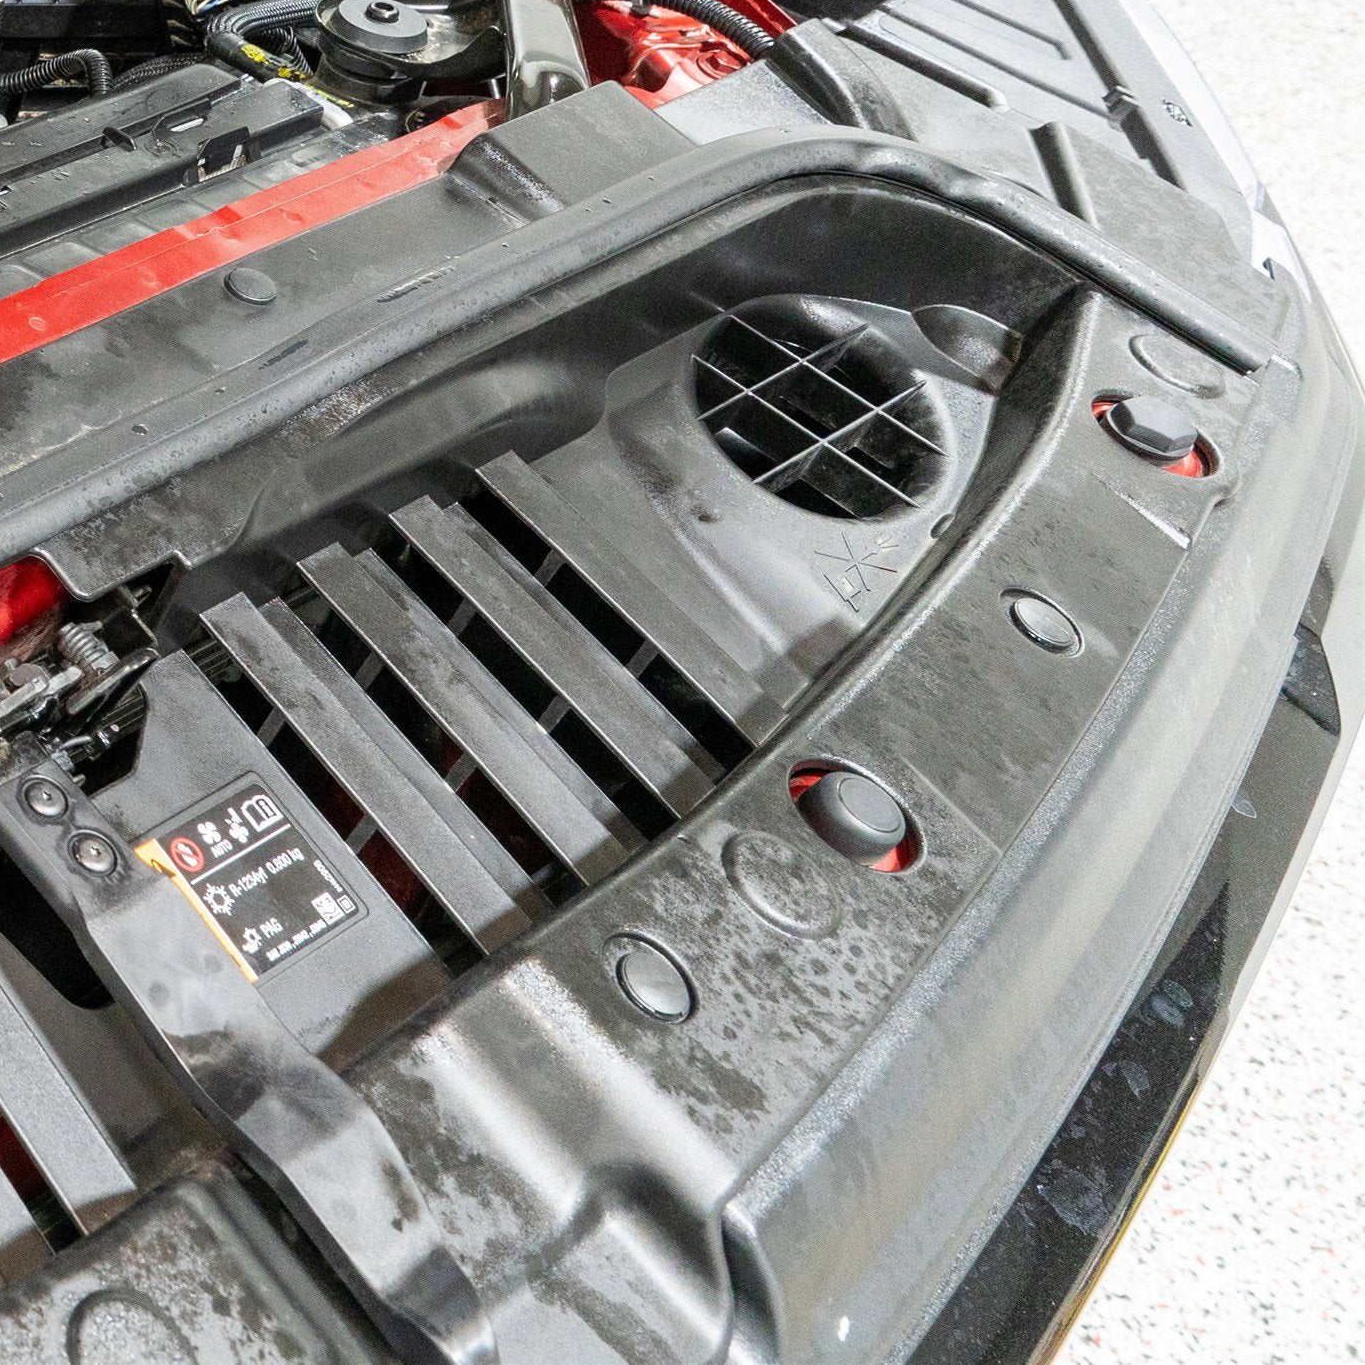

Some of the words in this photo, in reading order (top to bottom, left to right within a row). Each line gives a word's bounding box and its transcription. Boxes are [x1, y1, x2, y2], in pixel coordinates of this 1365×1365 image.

[210, 839, 233, 859] AUTO
[228, 866, 268, 897] R-1234yf
[266, 852, 292, 875] 0.600
[289, 847, 305, 863] kg
[259, 917, 283, 939] PAG
